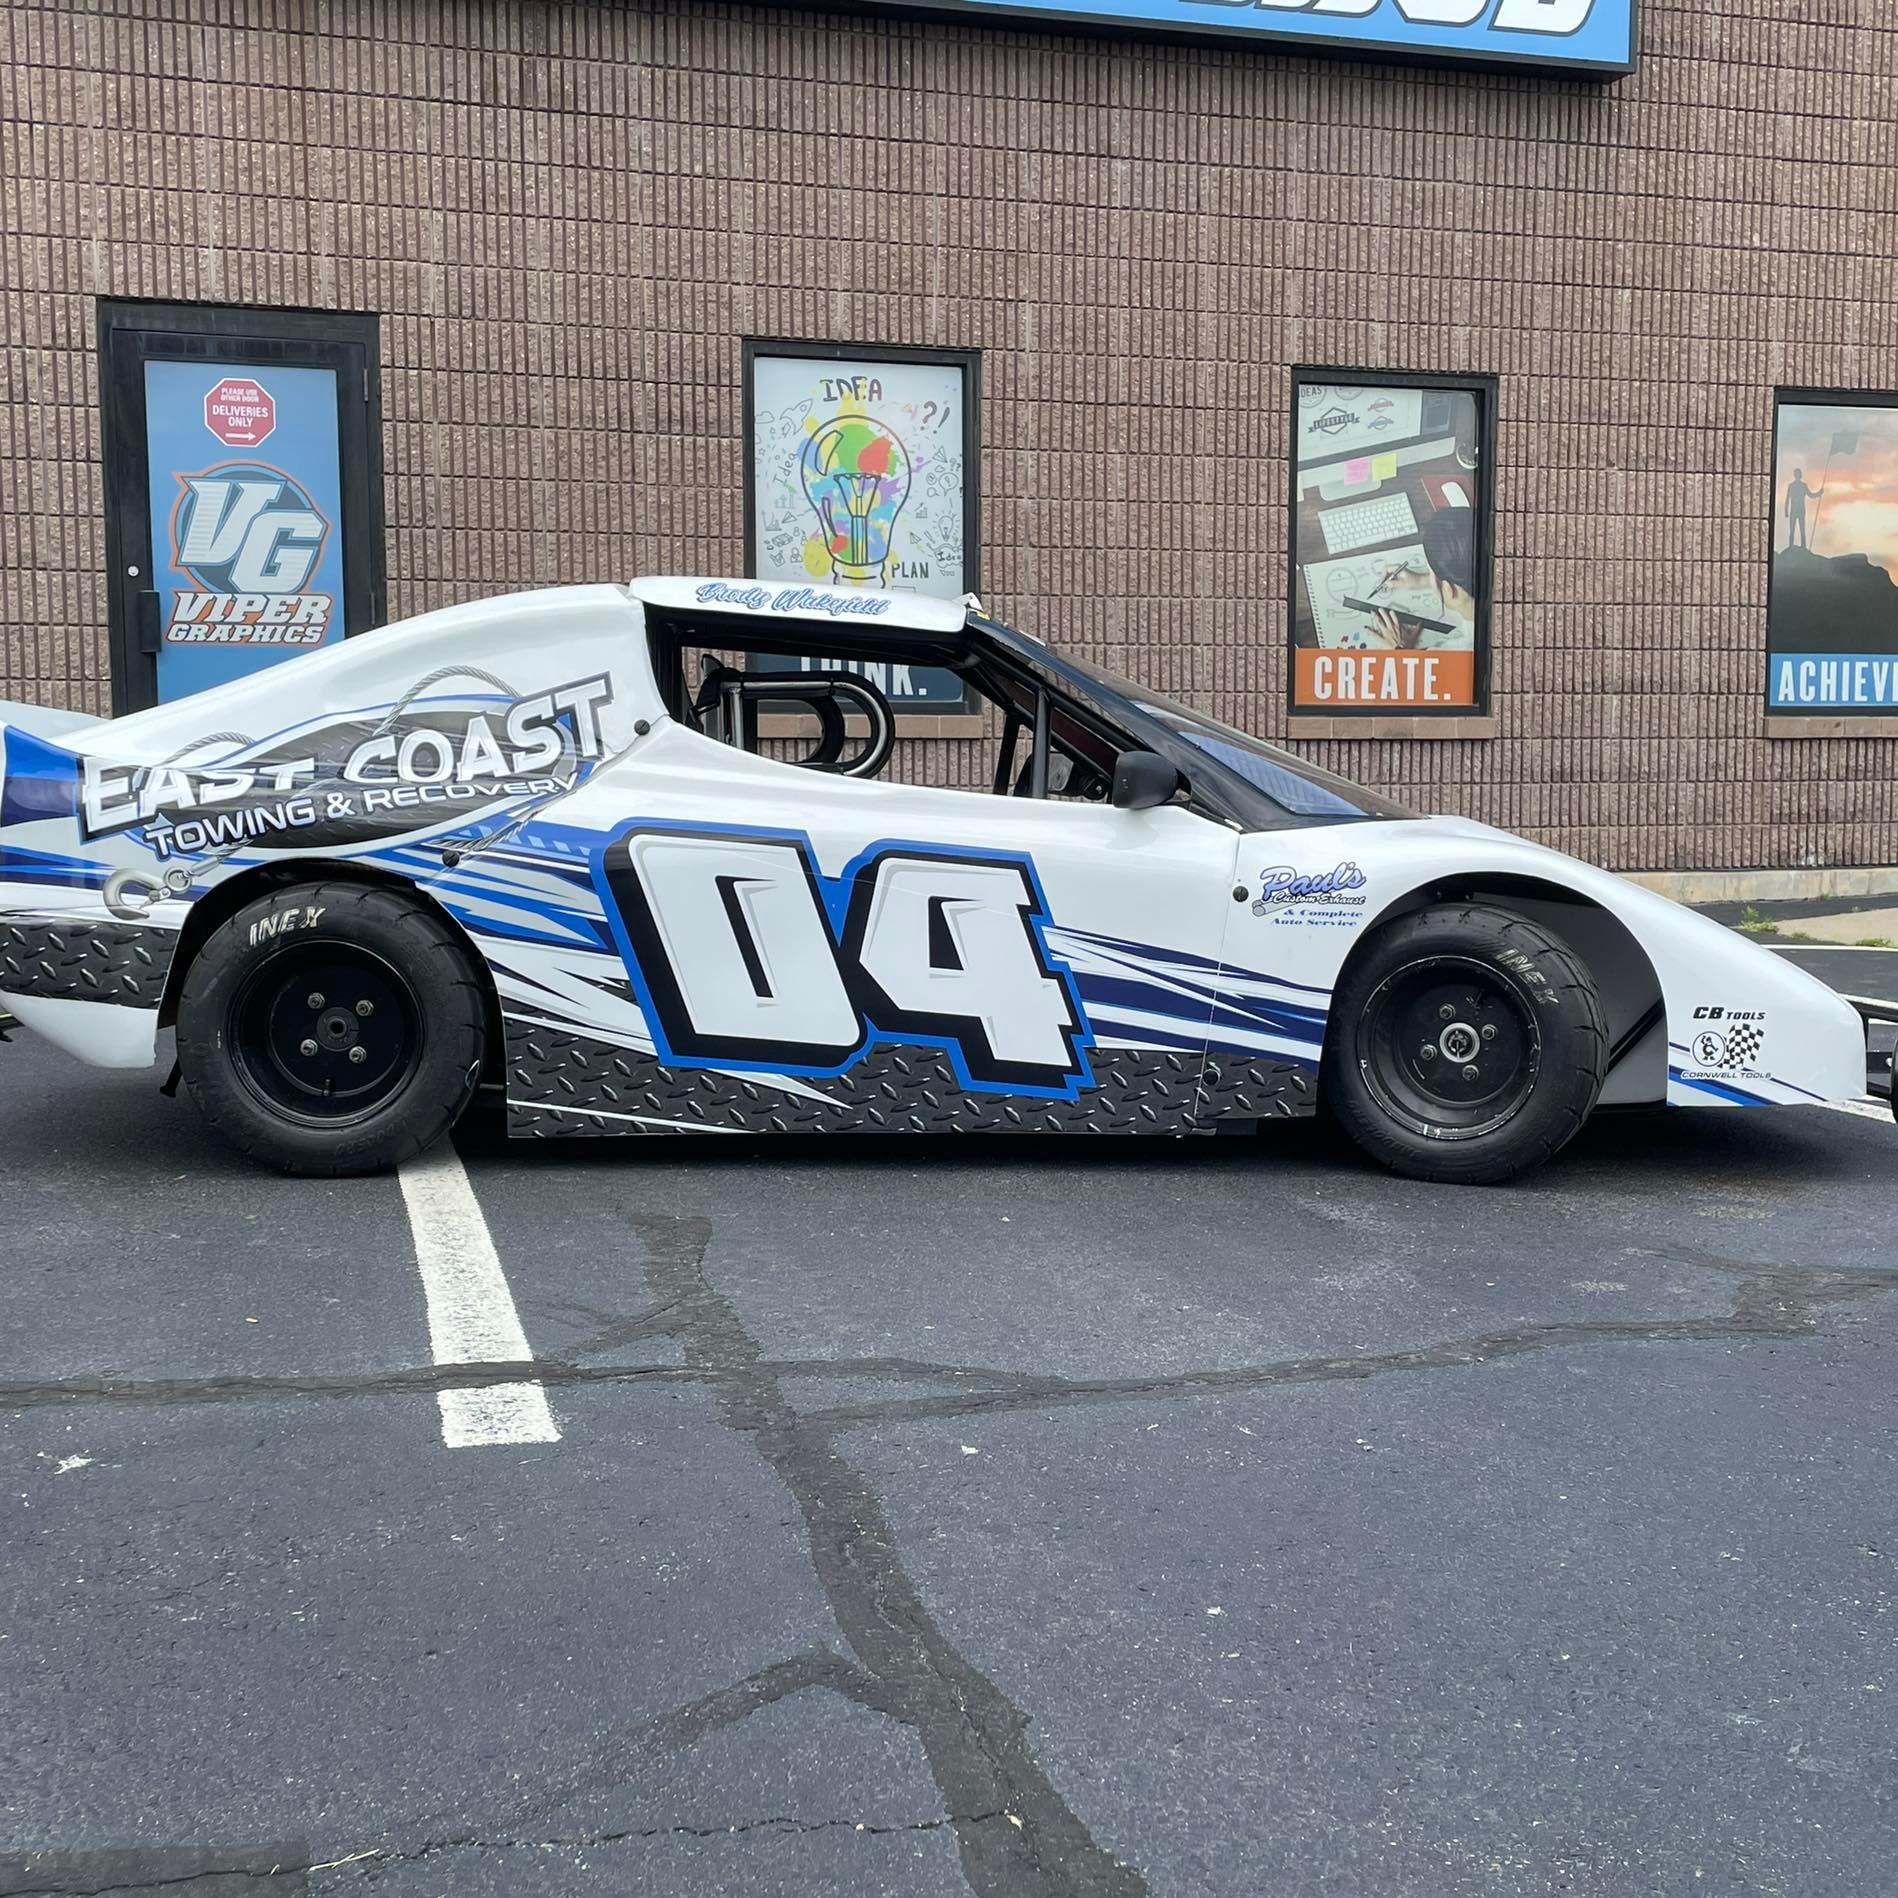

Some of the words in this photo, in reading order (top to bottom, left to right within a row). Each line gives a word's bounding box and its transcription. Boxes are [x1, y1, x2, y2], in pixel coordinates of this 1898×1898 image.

[820, 376, 882, 402] IDEA
[212, 405, 269, 417] DELIVERIES
[228, 417, 253, 428] ONLY
[179, 479, 325, 593] VG
[891, 562, 930, 580] PLAN
[173, 591, 333, 625] VIPER
[166, 622, 323, 644] GRAPHICS
[1314, 655, 1452, 700] CREATE.
[80, 755, 316, 833] EAST
[343, 676, 612, 784] COAST
[145, 797, 318, 856] TOWING
[326, 791, 356, 819] &
[363, 772, 578, 813] RECOVERY
[1259, 861, 1367, 902] Paul's
[1273, 891, 1318, 905] Custom
[1318, 892, 1366, 906] Exhaust
[248, 906, 327, 946] INEX
[1271, 918, 1303, 926] Auto
[1306, 919, 1358, 927] Service
[1299, 909, 1364, 919] Complete
[603, 826, 1084, 1088] 04
[1692, 1006, 1725, 1020] CB
[1726, 1011, 1766, 1021] TOOLS
[1681, 1070, 1738, 1080] CORNWELL
[1740, 1070, 1772, 1080] TOOLS
